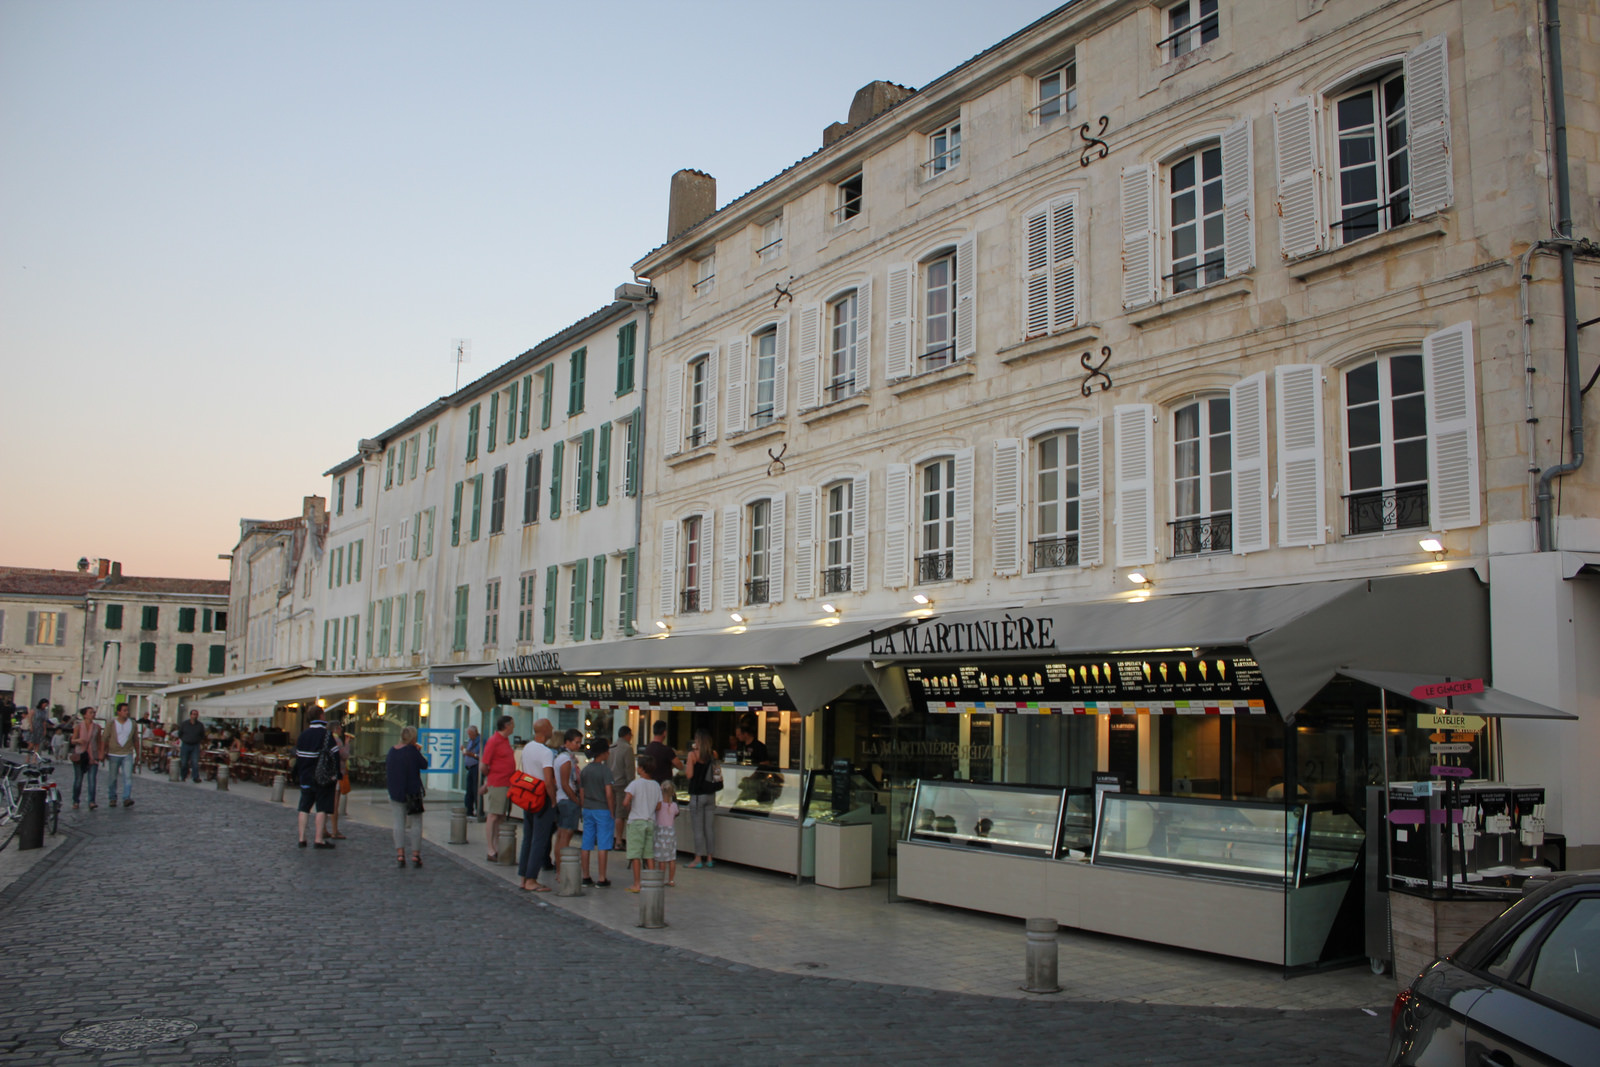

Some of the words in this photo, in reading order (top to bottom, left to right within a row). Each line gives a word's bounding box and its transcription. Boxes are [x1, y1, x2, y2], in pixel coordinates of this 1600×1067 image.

[868, 630, 897, 655] LA
[902, 614, 1056, 655] MARTINIÈRE
[496, 658, 508, 675] LA
[508, 650, 561, 674] MARTINIÈRE
[1425, 688, 1434, 696] LE
[1437, 682, 1473, 694] GLACIER
[1433, 716, 1465, 725] L'ATELIER
[423, 734, 453, 752] RÉ
